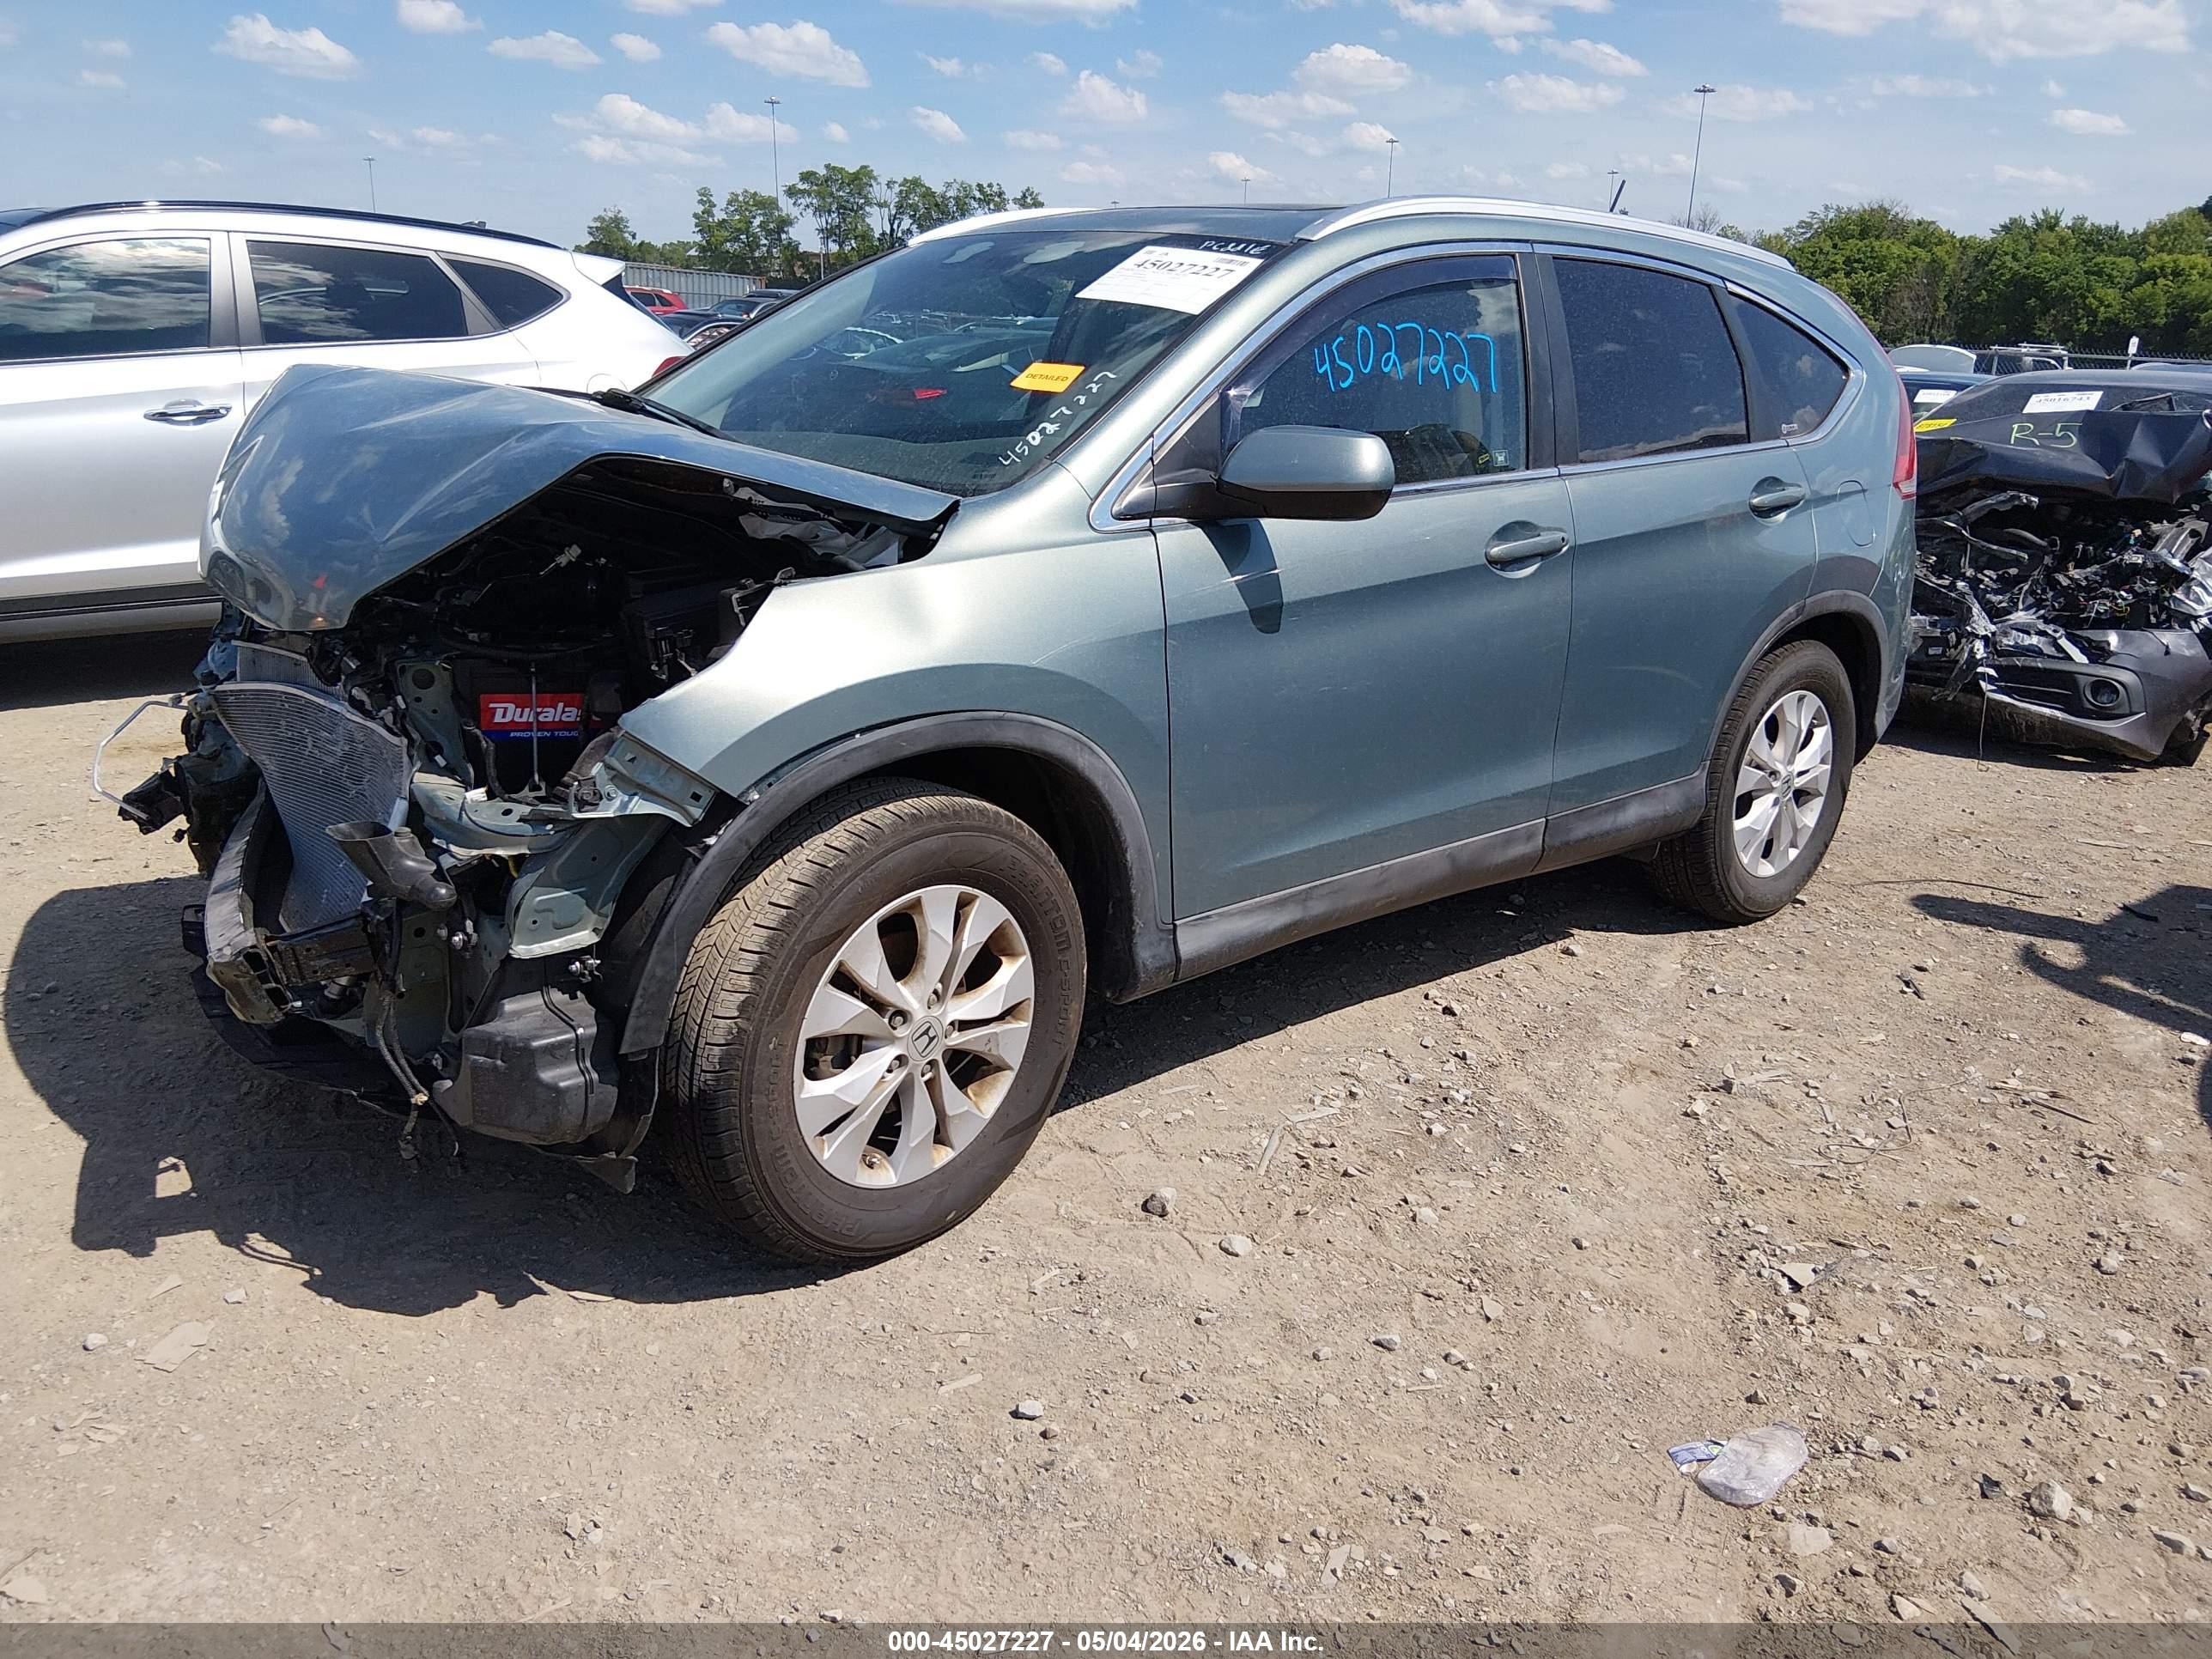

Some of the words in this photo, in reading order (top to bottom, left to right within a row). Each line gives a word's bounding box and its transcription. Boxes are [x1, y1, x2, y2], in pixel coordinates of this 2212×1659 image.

[1133, 258, 1237, 279] 45027227
[1313, 322, 1498, 393] 45027227
[1025, 373, 1069, 382] DETAILED
[998, 371, 1117, 465] 45027227
[2010, 422, 2083, 448] R-5
